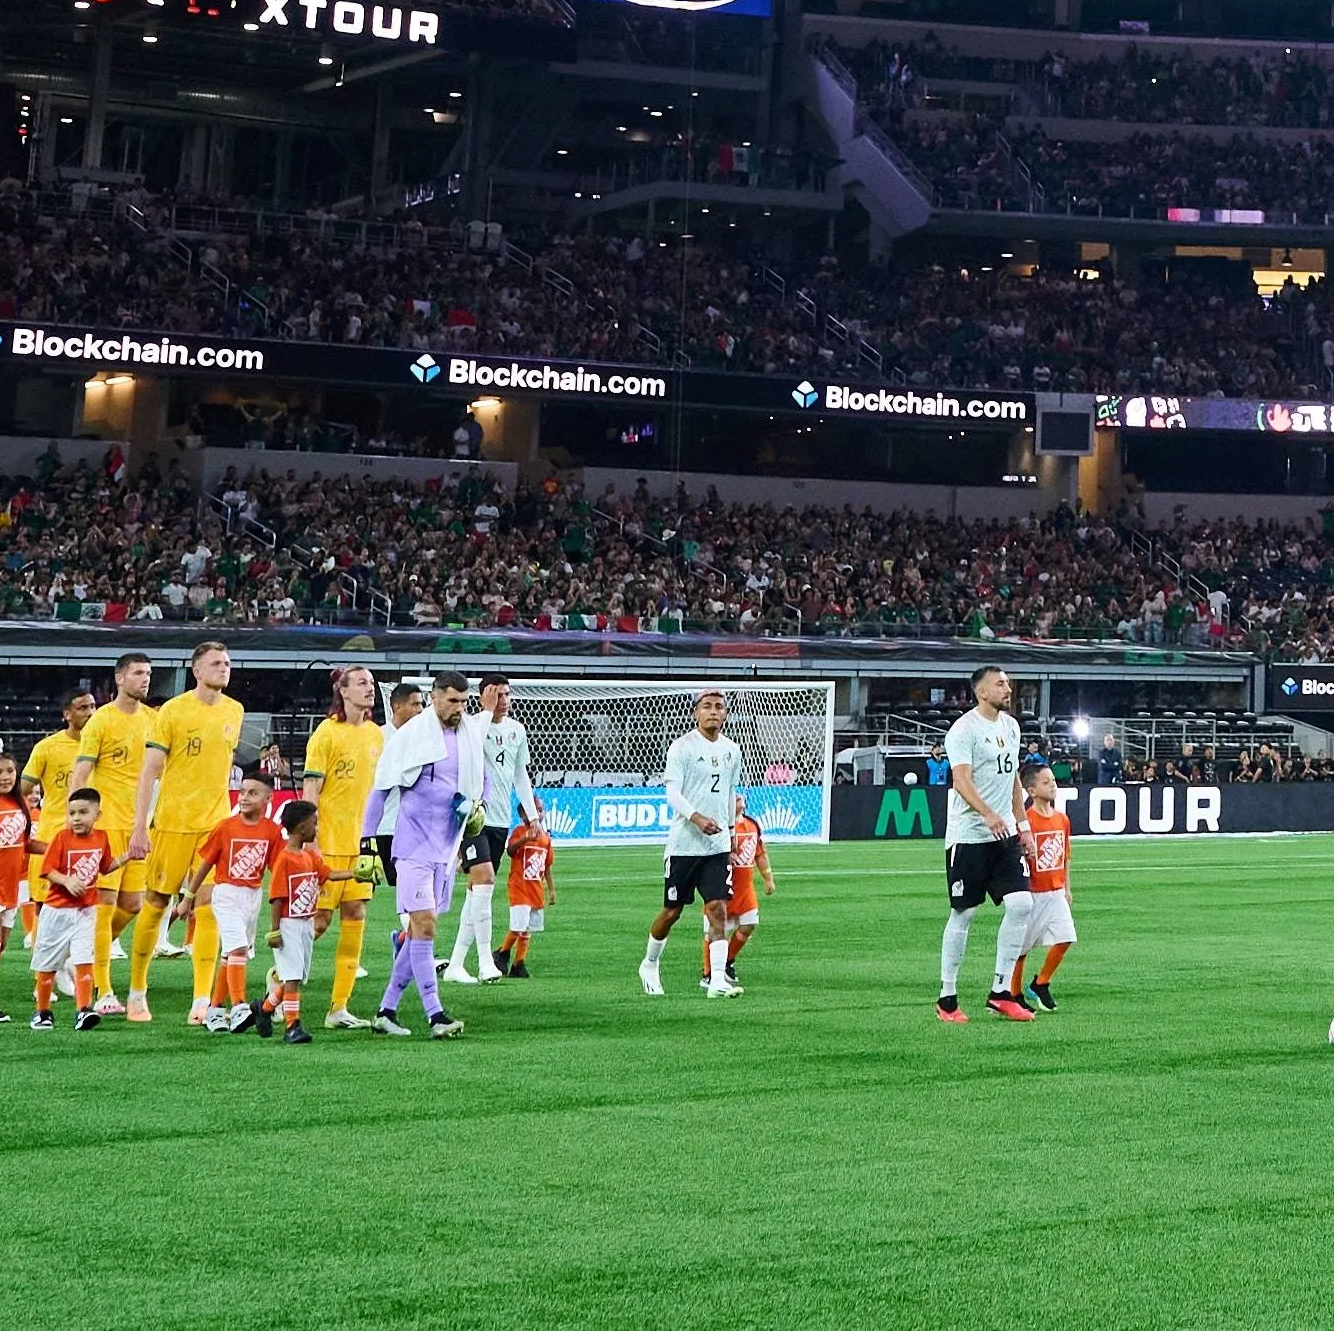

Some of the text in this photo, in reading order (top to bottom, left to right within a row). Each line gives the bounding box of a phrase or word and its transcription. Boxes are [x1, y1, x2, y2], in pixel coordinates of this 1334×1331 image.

[12, 328, 264, 370] Blockchain.com
[449, 359, 666, 398] Blockchain.com
[826, 386, 1026, 420] Blockchain.com
[186, 736, 202, 758] 19
[495, 750, 505, 767] 4
[996, 753, 1014, 774] 16
[711, 773, 721, 793] 2
[599, 804, 656, 827] BUD
